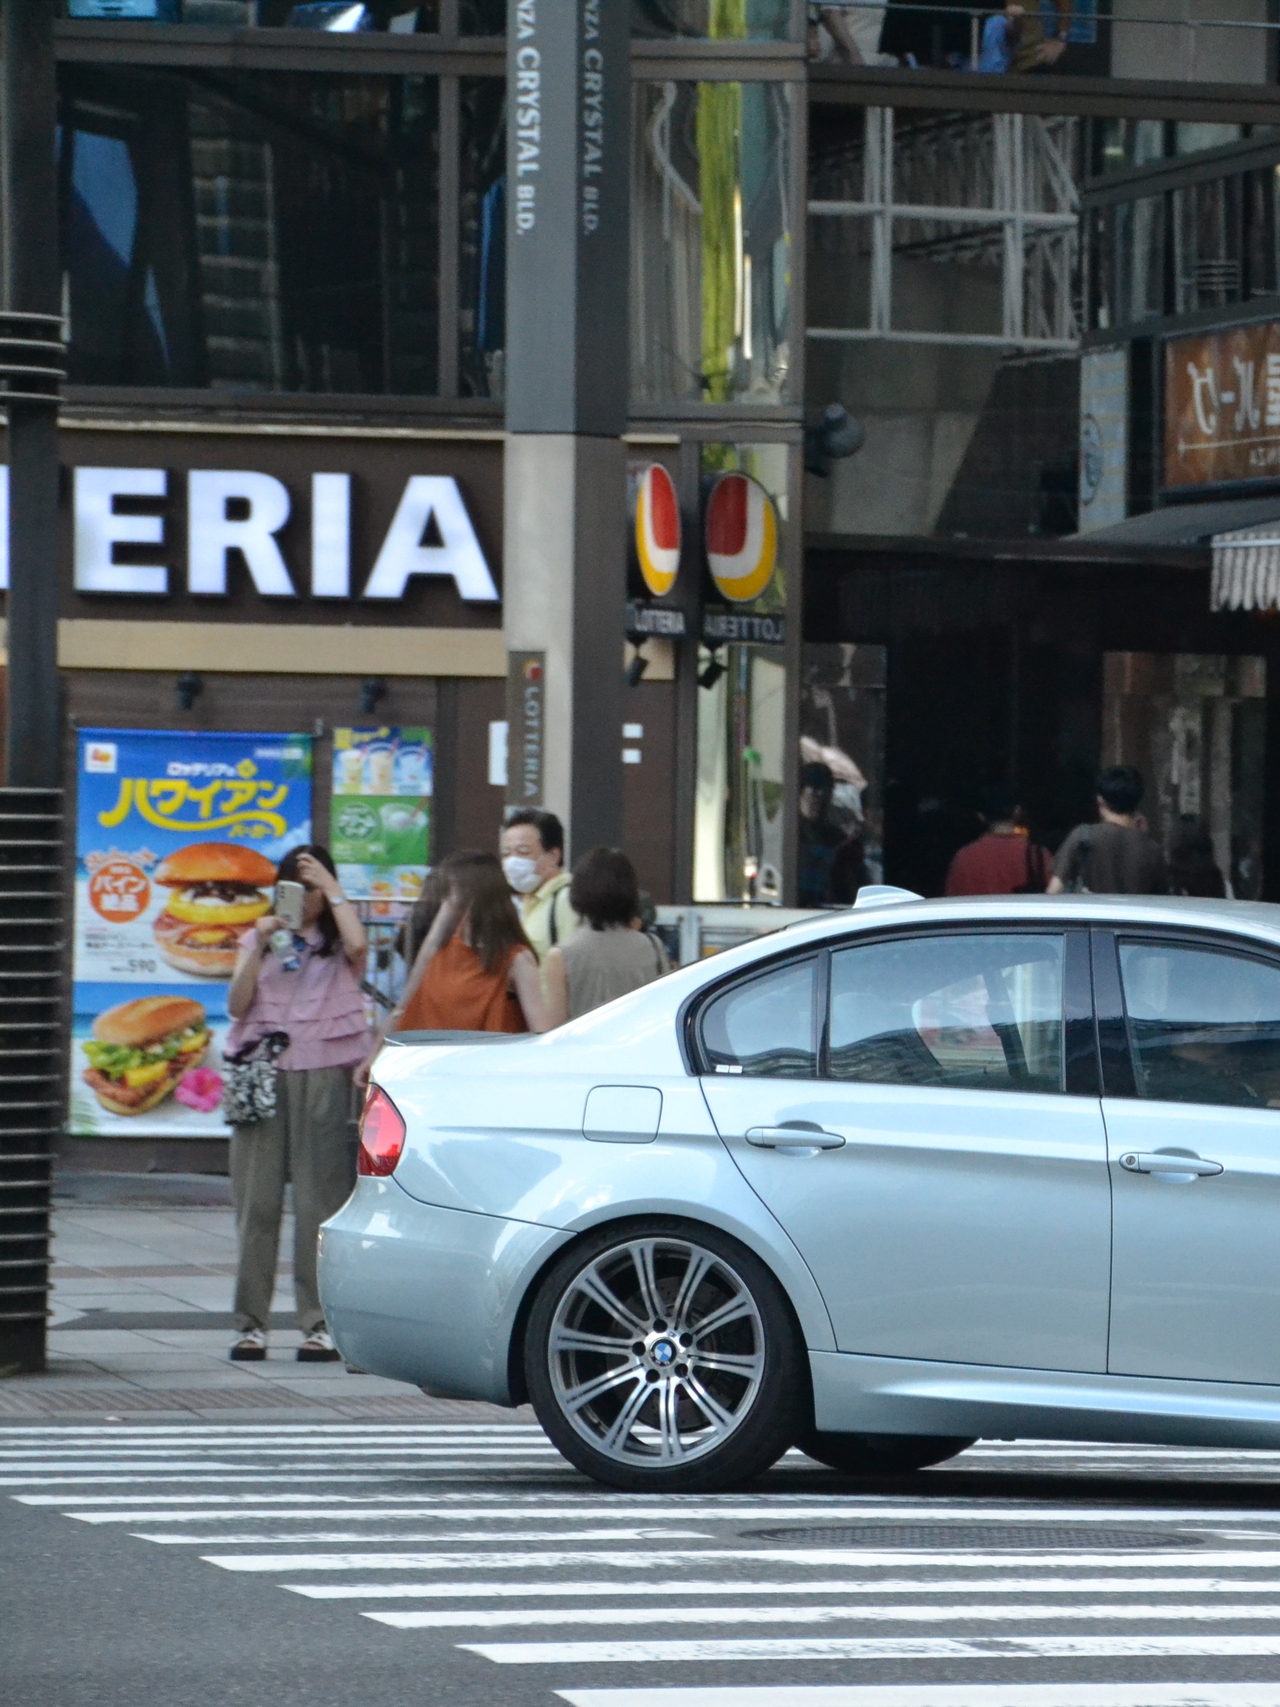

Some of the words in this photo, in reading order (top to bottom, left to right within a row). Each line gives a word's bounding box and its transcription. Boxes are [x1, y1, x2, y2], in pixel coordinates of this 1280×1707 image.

[516, 46, 541, 178] CRYSTAL
[583, 48, 603, 178] CRYSTAL
[516, 184, 535, 236] BLD.
[0, 464, 500, 600] ERIA
[524, 686, 541, 797] LOTTERIA
[98, 777, 289, 838] ハワイアン
